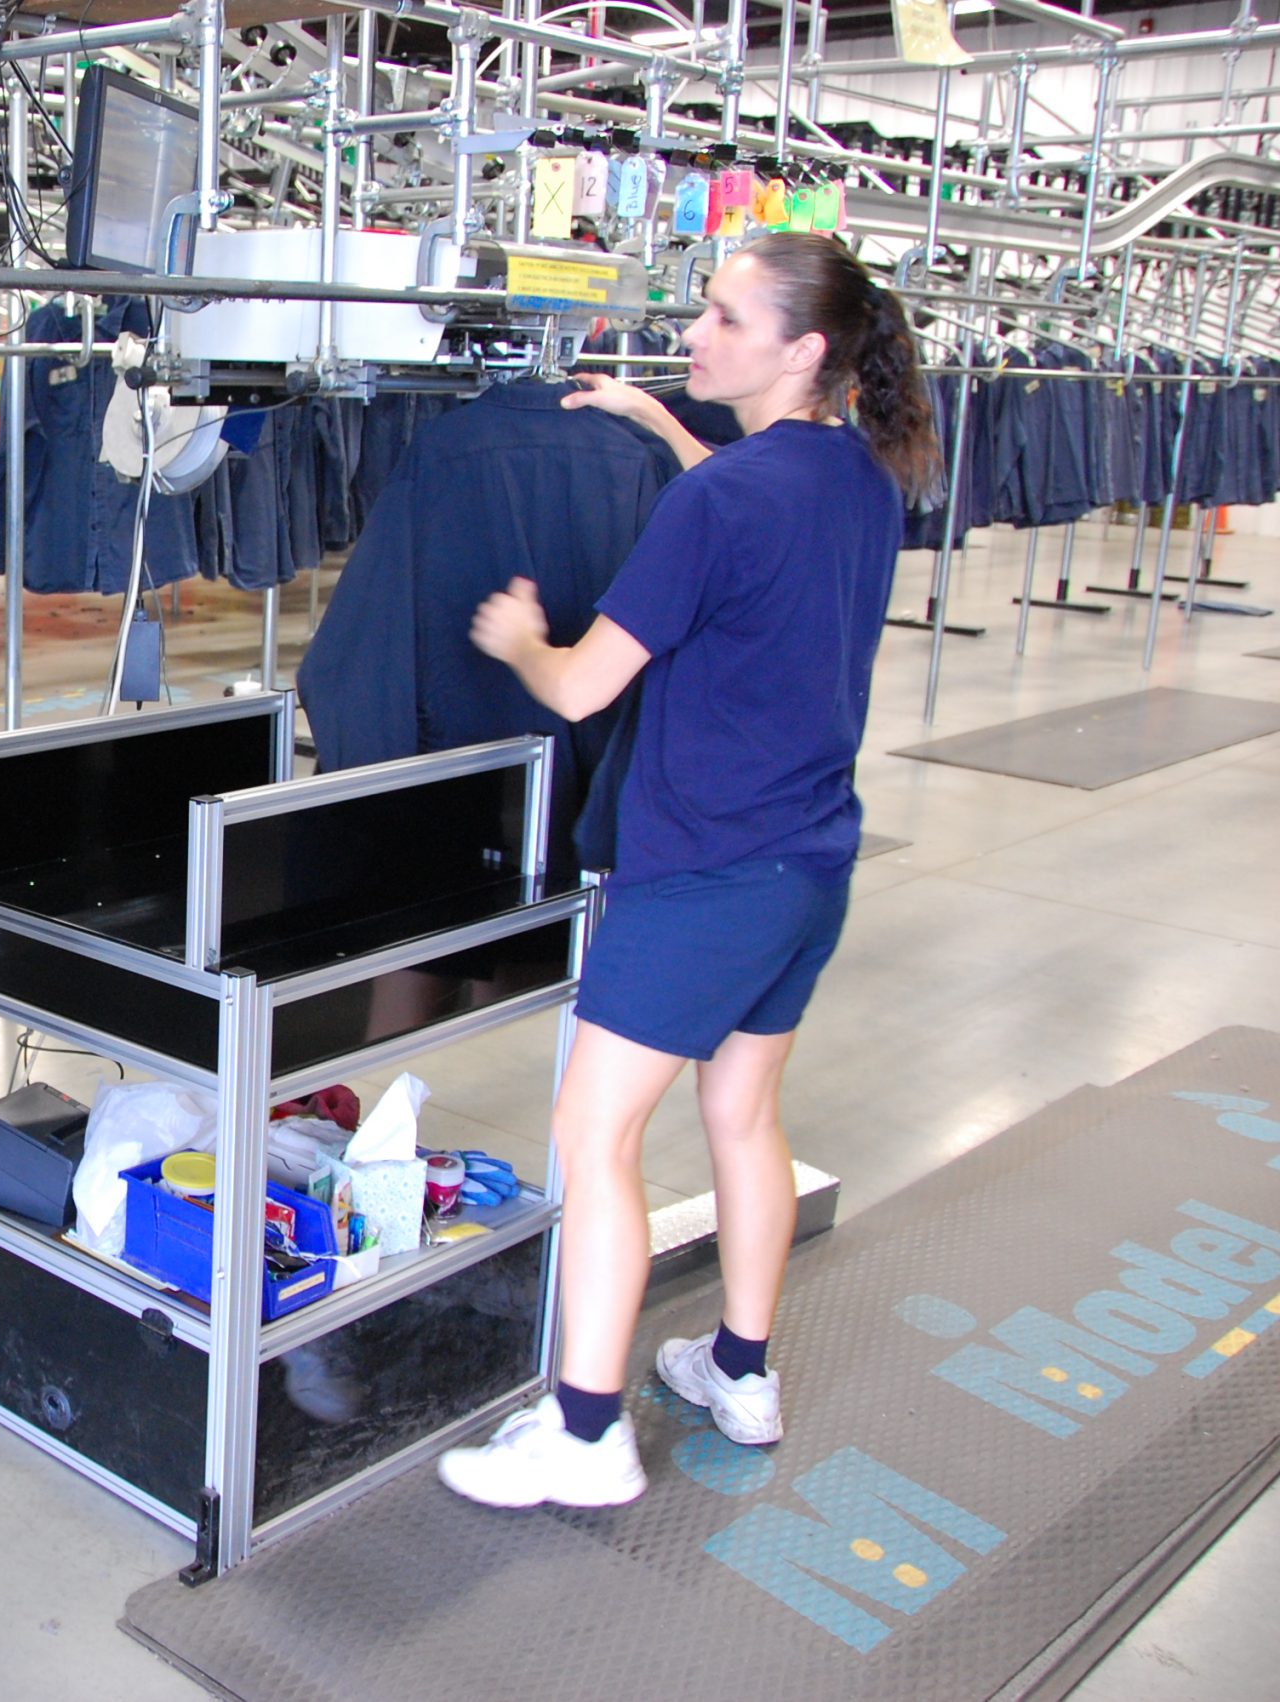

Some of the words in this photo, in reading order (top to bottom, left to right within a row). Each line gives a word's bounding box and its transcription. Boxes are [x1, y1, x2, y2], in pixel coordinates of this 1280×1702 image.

[580, 175, 597, 199] 12
[625, 174, 643, 213] Blue
[725, 176, 734, 194] 5
[541, 180, 566, 215] X
[683, 199, 696, 221] 6
